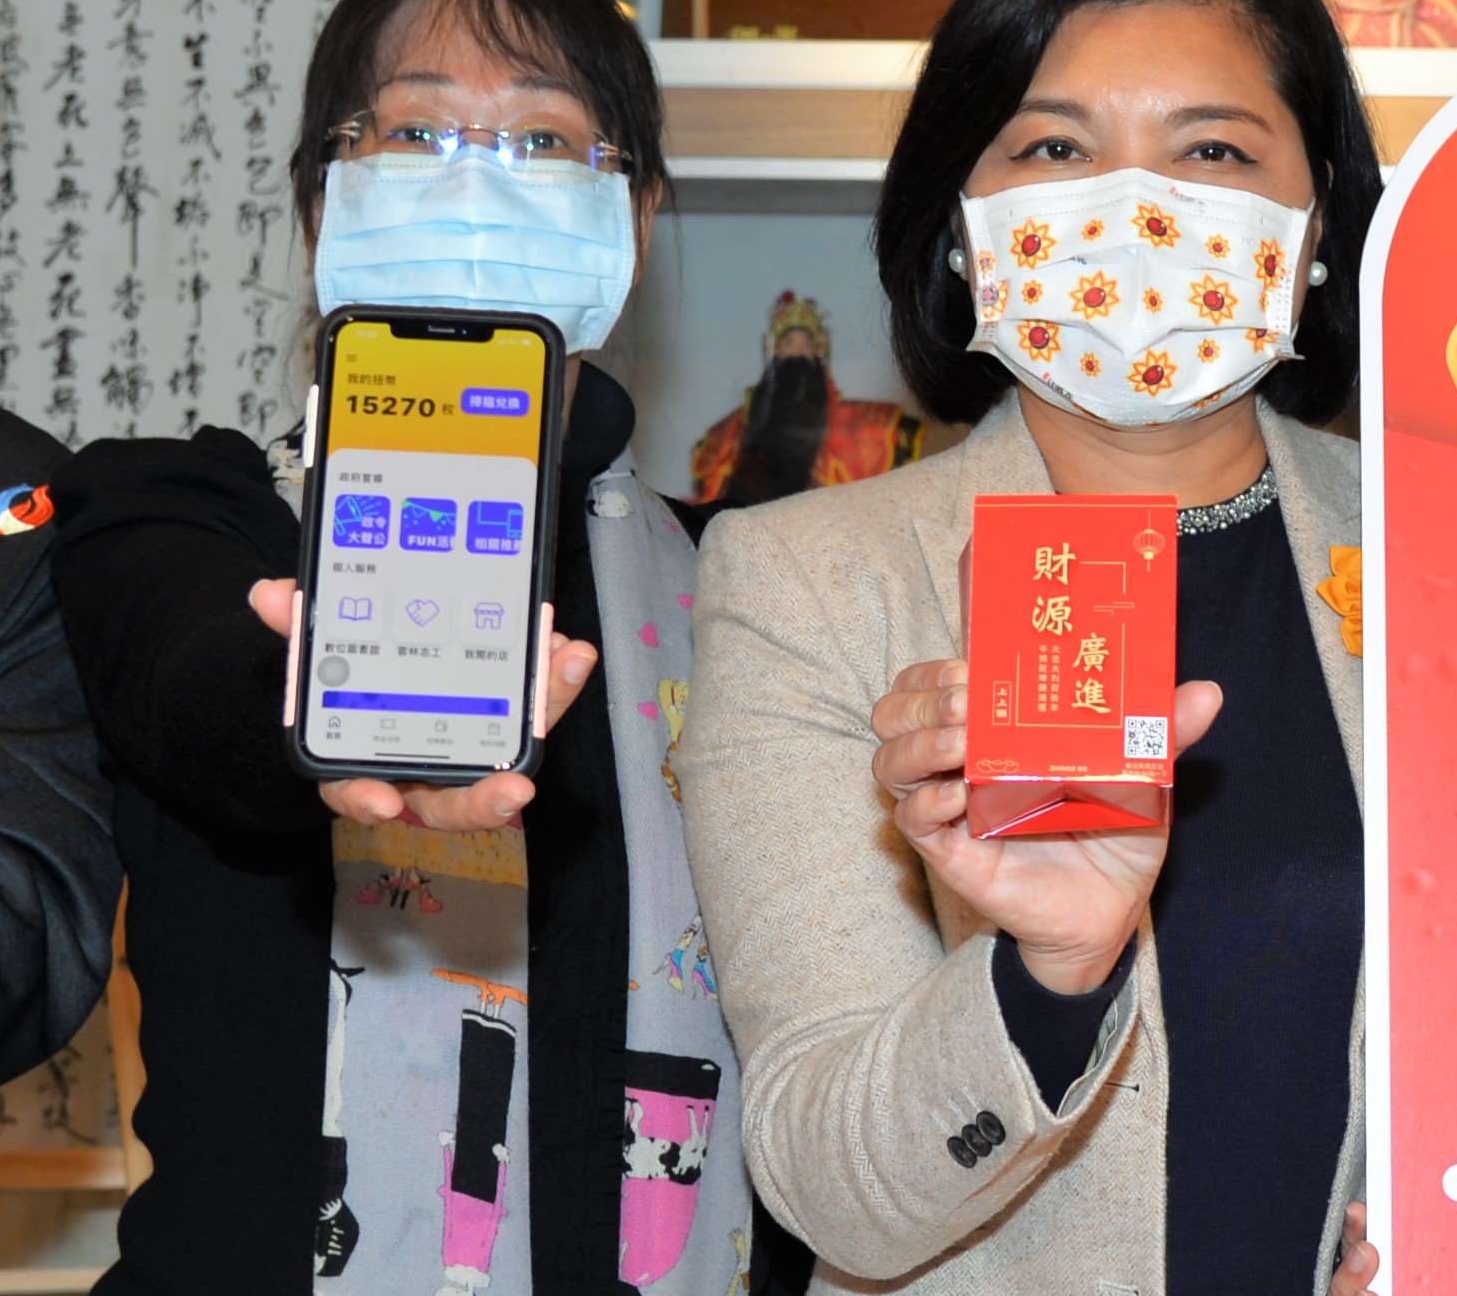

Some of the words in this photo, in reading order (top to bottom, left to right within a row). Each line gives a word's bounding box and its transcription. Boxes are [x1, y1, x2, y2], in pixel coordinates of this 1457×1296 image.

[346, 395, 436, 417] 15270
[1031, 542, 1076, 636] 財源
[1070, 632, 1112, 714] 廣進
